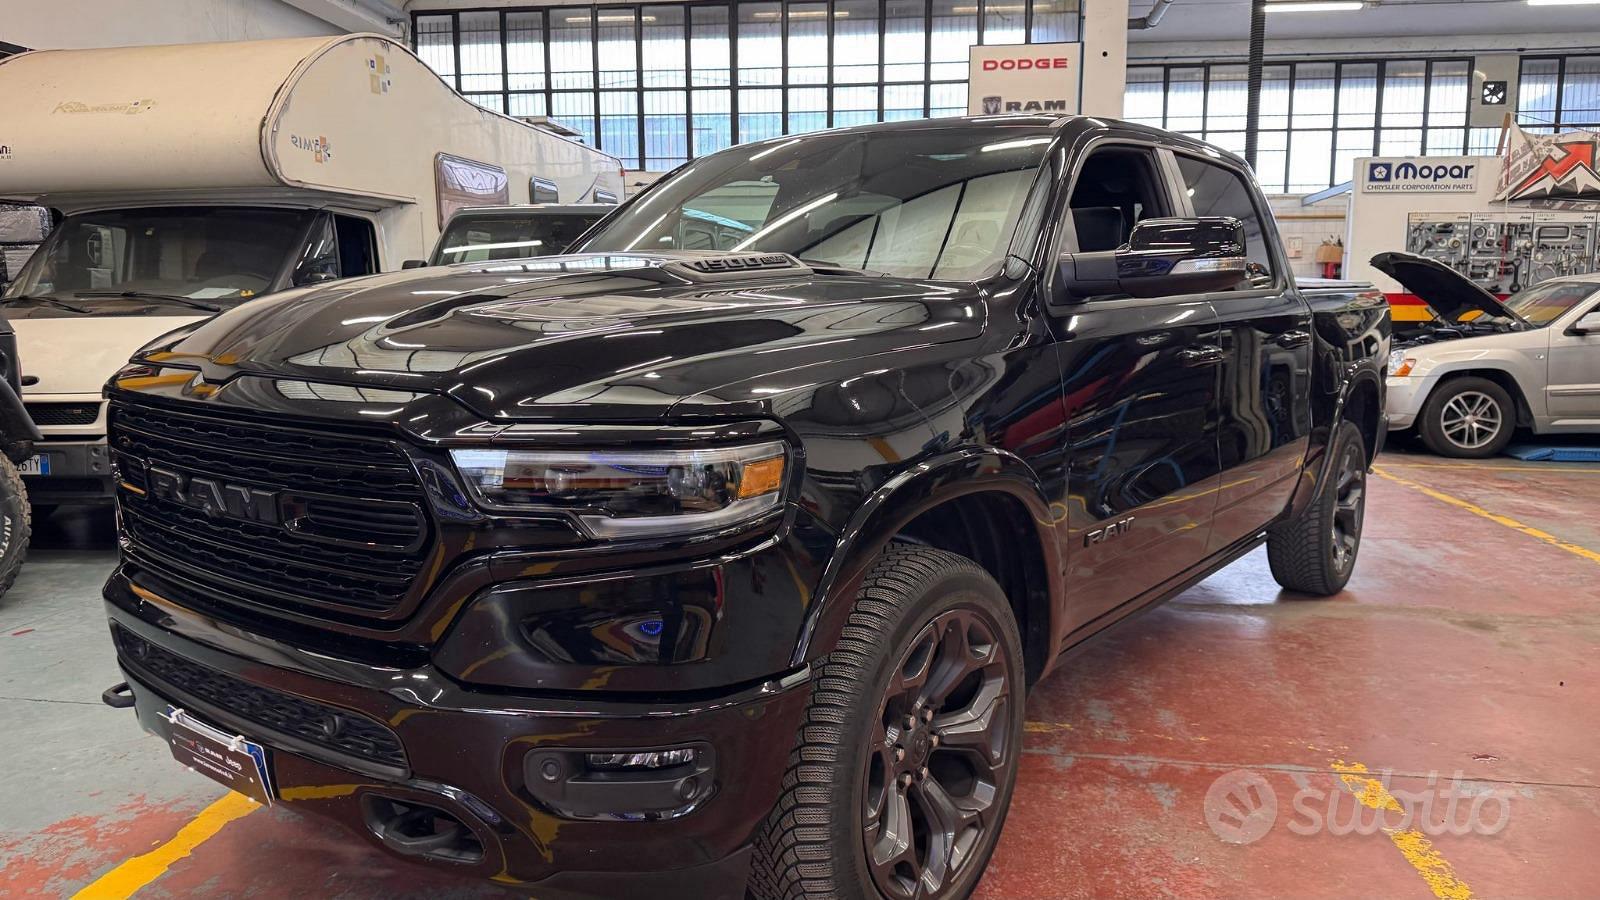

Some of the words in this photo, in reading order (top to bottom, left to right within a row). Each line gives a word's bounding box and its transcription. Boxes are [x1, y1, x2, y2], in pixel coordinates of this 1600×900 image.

[983, 58, 1068, 71] DODGE
[1005, 100, 1066, 112] RAM
[1395, 162, 1475, 182] Mopar
[694, 257, 762, 271] 1500
[149, 467, 280, 524] RAM
[1083, 516, 1135, 547] RAM
